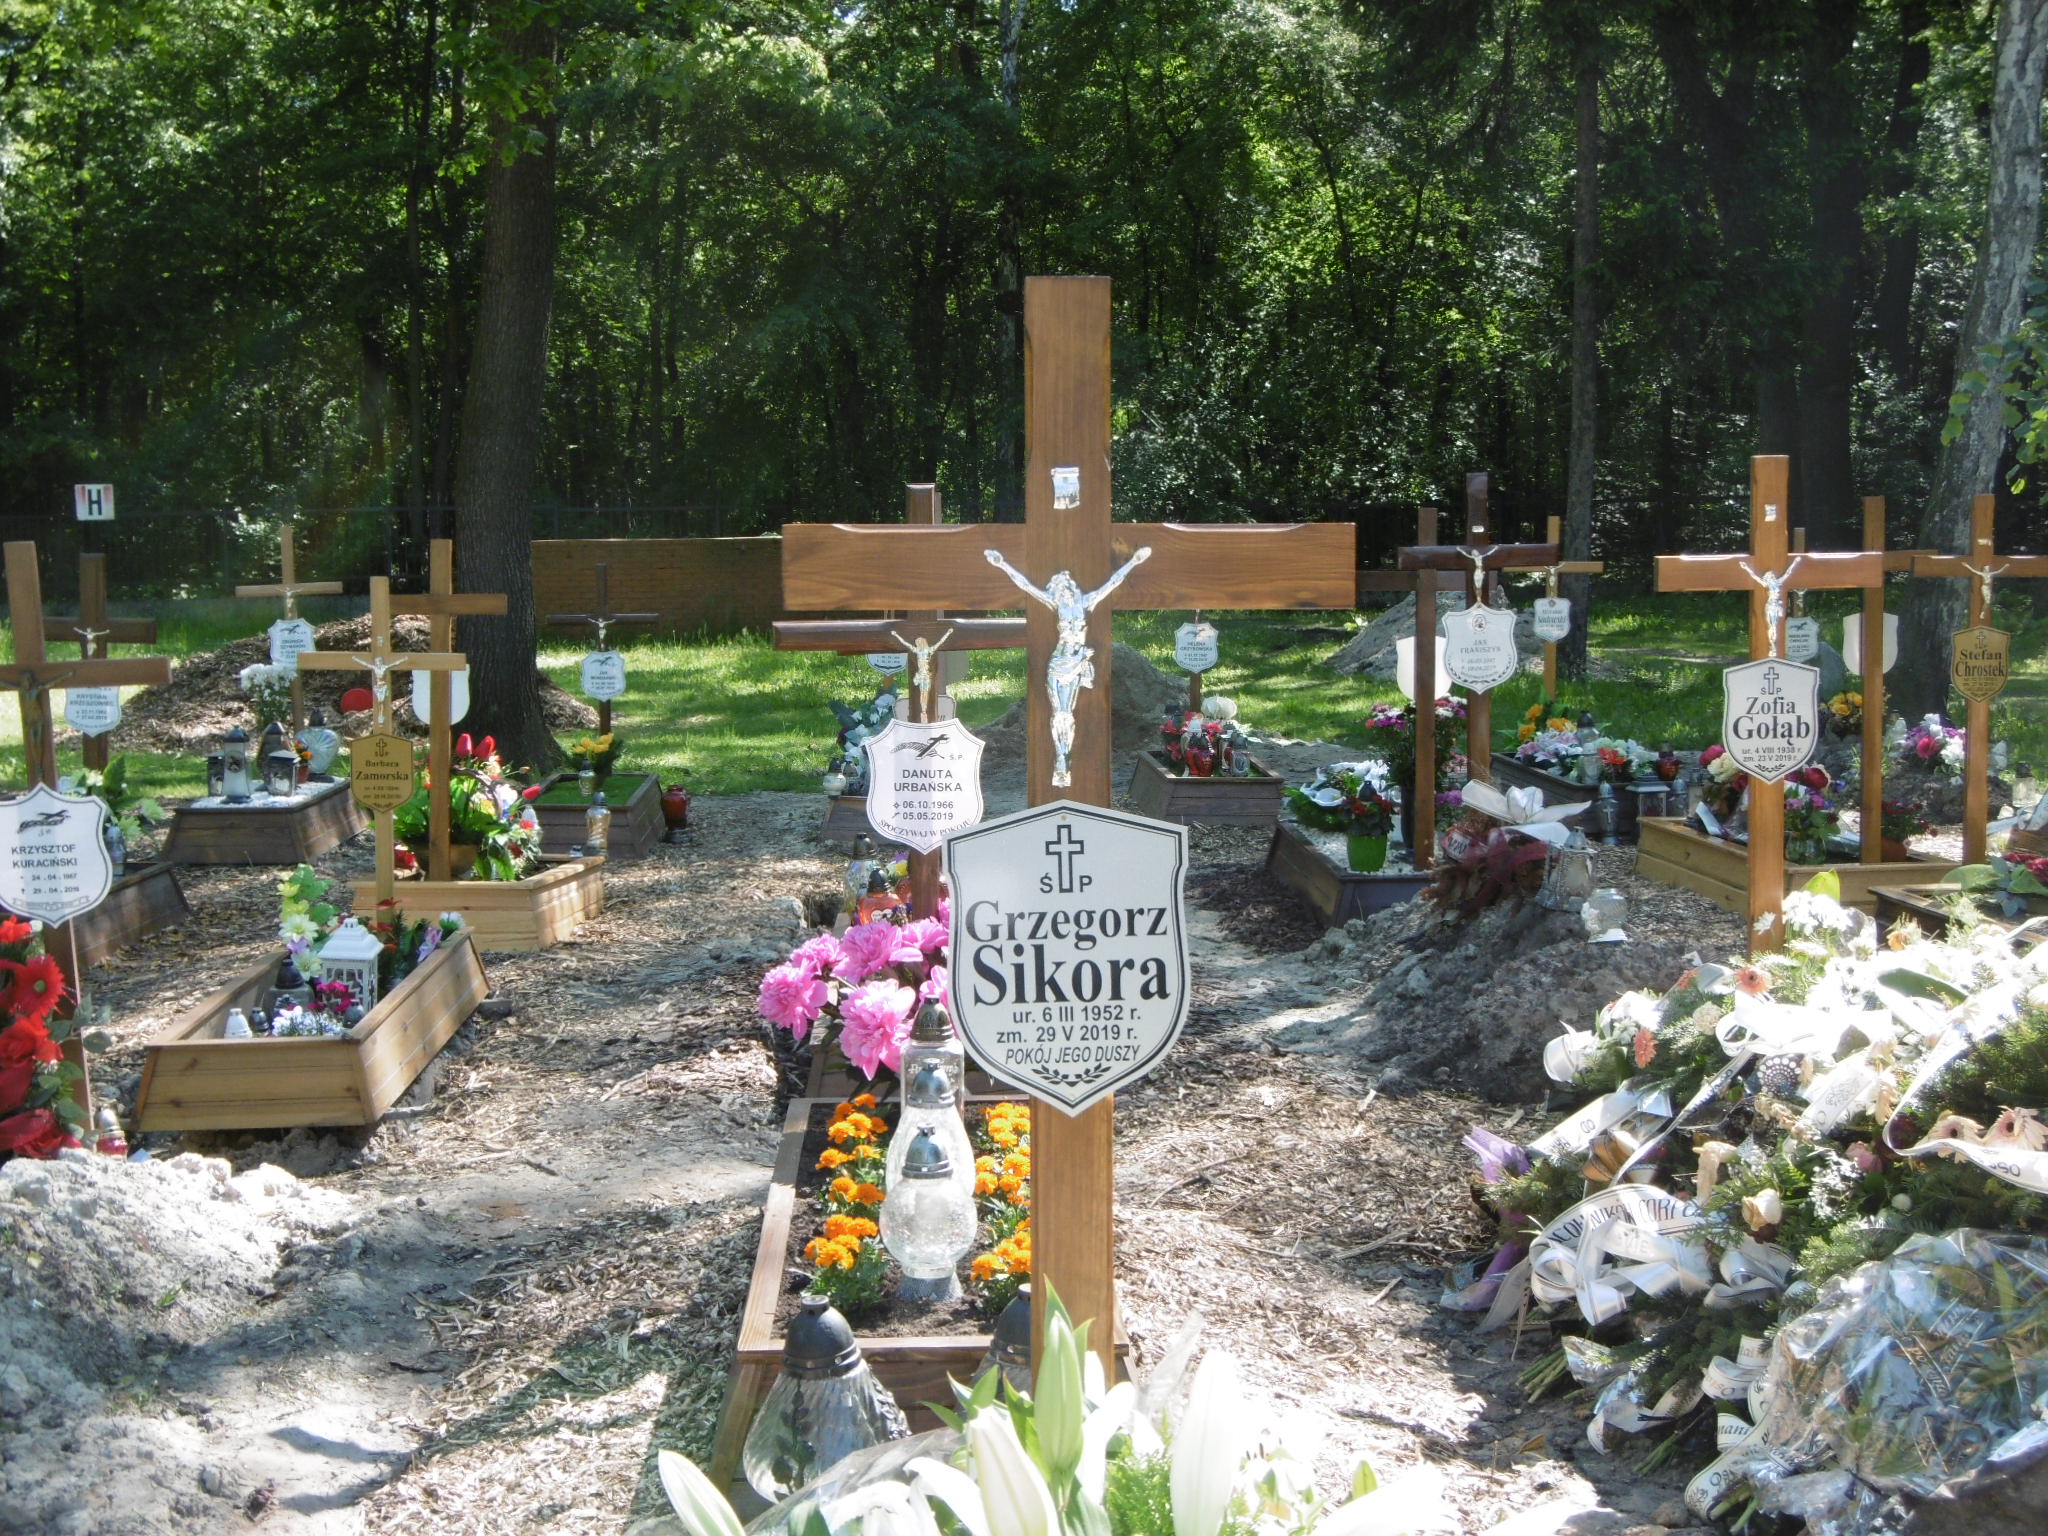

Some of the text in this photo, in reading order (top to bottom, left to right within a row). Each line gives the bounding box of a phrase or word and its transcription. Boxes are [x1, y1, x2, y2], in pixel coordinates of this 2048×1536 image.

[87, 489, 102, 516] H
[1960, 648, 2002, 660] Stefan
[1955, 660, 2005, 677] Chrostek
[1746, 696, 1796, 715] Zofia
[1732, 715, 1810, 746] Gołąb
[1762, 746, 1774, 754] VIII
[355, 771, 409, 781] Zamorska
[902, 769, 953, 779] DANUTA
[893, 781, 963, 792] URBAŃSKA
[902, 812, 954, 820] 05.05.2019
[11, 844, 77, 855] KRZYSZTOF
[12, 856, 78, 869] KURACIŃSKI
[1079, 875, 1092, 892] P
[965, 900, 1168, 950] Grzegorz
[973, 943, 1171, 1006] Sikora
[1013, 1004, 1141, 1023] ur. 6 III 1952 r.
[996, 1024, 1138, 1044] zm. 29 V 2019 r.
[1005, 1044, 1140, 1064] POKÓJ JEGO DUSZY
